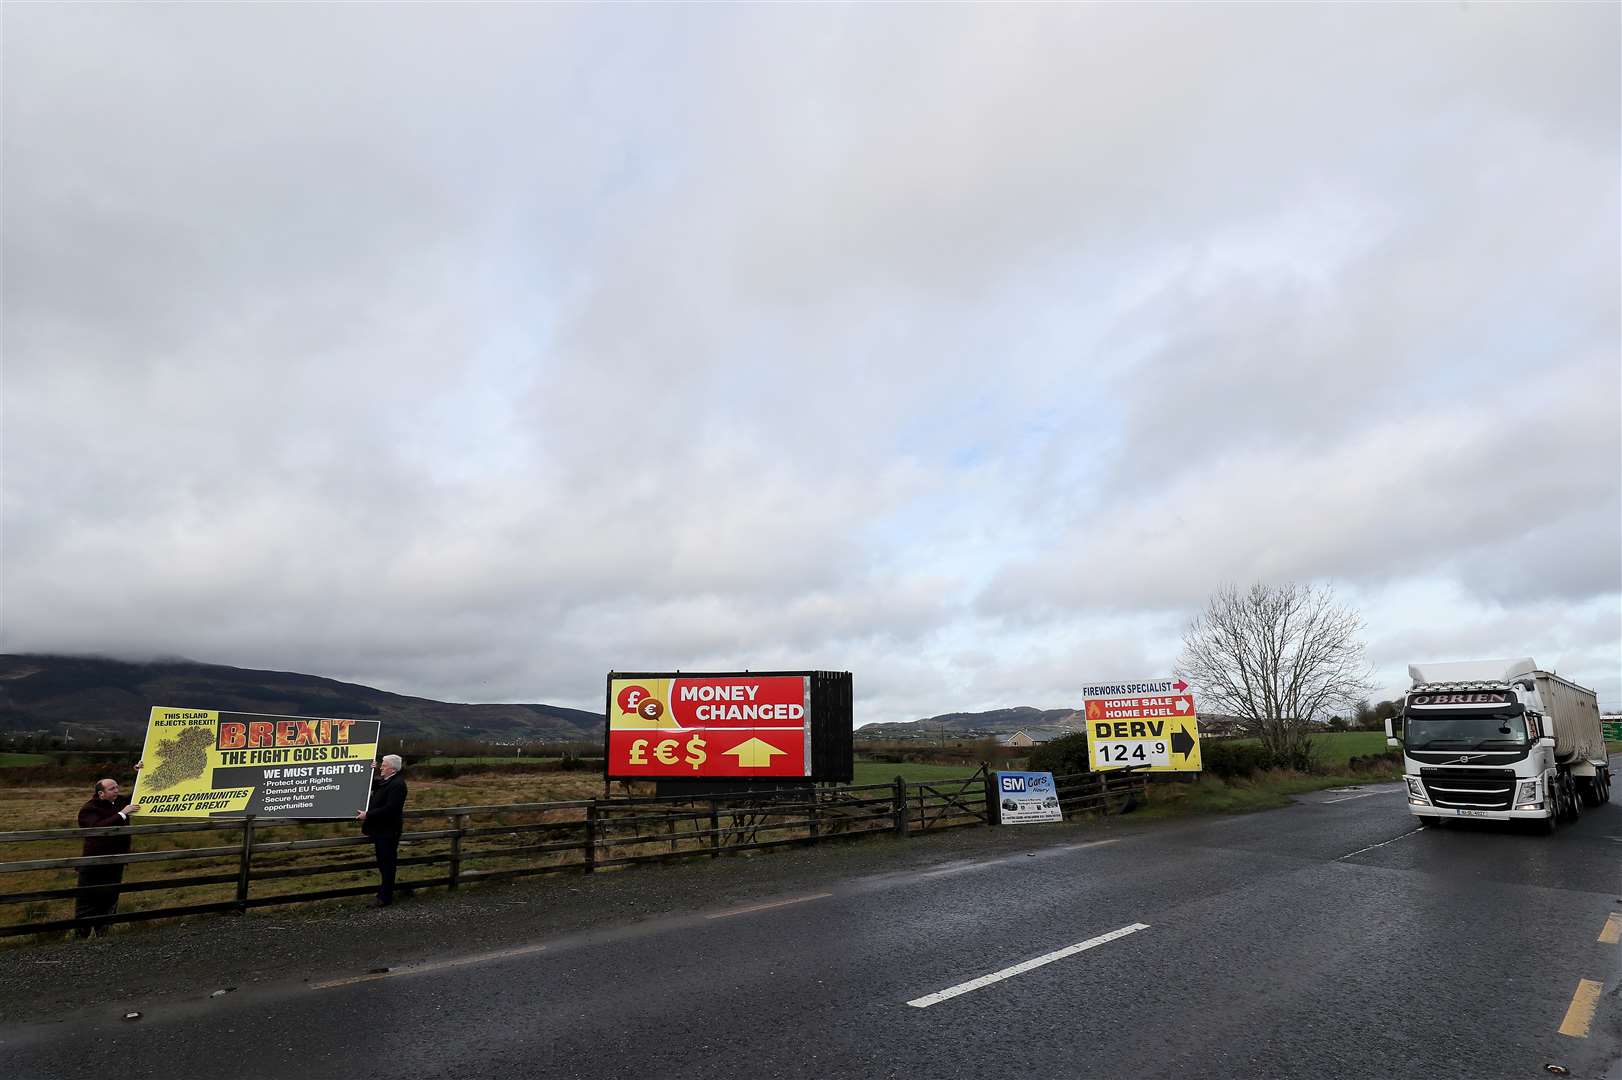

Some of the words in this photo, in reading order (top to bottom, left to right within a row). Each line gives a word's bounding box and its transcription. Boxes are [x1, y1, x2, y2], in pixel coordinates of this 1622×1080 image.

[680, 685, 759, 702] MONEY
[1083, 684, 1126, 697] FIREWORKS
[1127, 682, 1172, 694] SPECIALIST
[1104, 698, 1139, 708] HOME
[1142, 697, 1173, 706] SALE
[1414, 693, 1506, 705] O'BRIEN
[695, 704, 805, 720] CHANGED
[1105, 709, 1140, 718] HOME
[1143, 708, 1174, 717] FUEL
[219, 719, 356, 749] BREXIT
[1095, 721, 1165, 738] DERV
[221, 751, 247, 765] THE
[250, 749, 290, 764] FIGHT
[293, 747, 328, 761] GOES
[263, 769, 281, 779] WE
[283, 767, 314, 778] MUST
[316, 765, 346, 776] FIGHT
[348, 764, 364, 773] TO:
[309, 777, 333, 785] Rights
[1003, 778, 1025, 790] SM
[265, 787, 297, 795] Demand
[311, 784, 340, 792] Funding
[139, 794, 181, 805] BORDER
[182, 789, 249, 802] COMMUNITIES
[293, 793, 315, 801] future
[149, 802, 194, 813] AGAINST
[195, 800, 230, 810] BREXIT
[264, 802, 313, 812] opportunities
